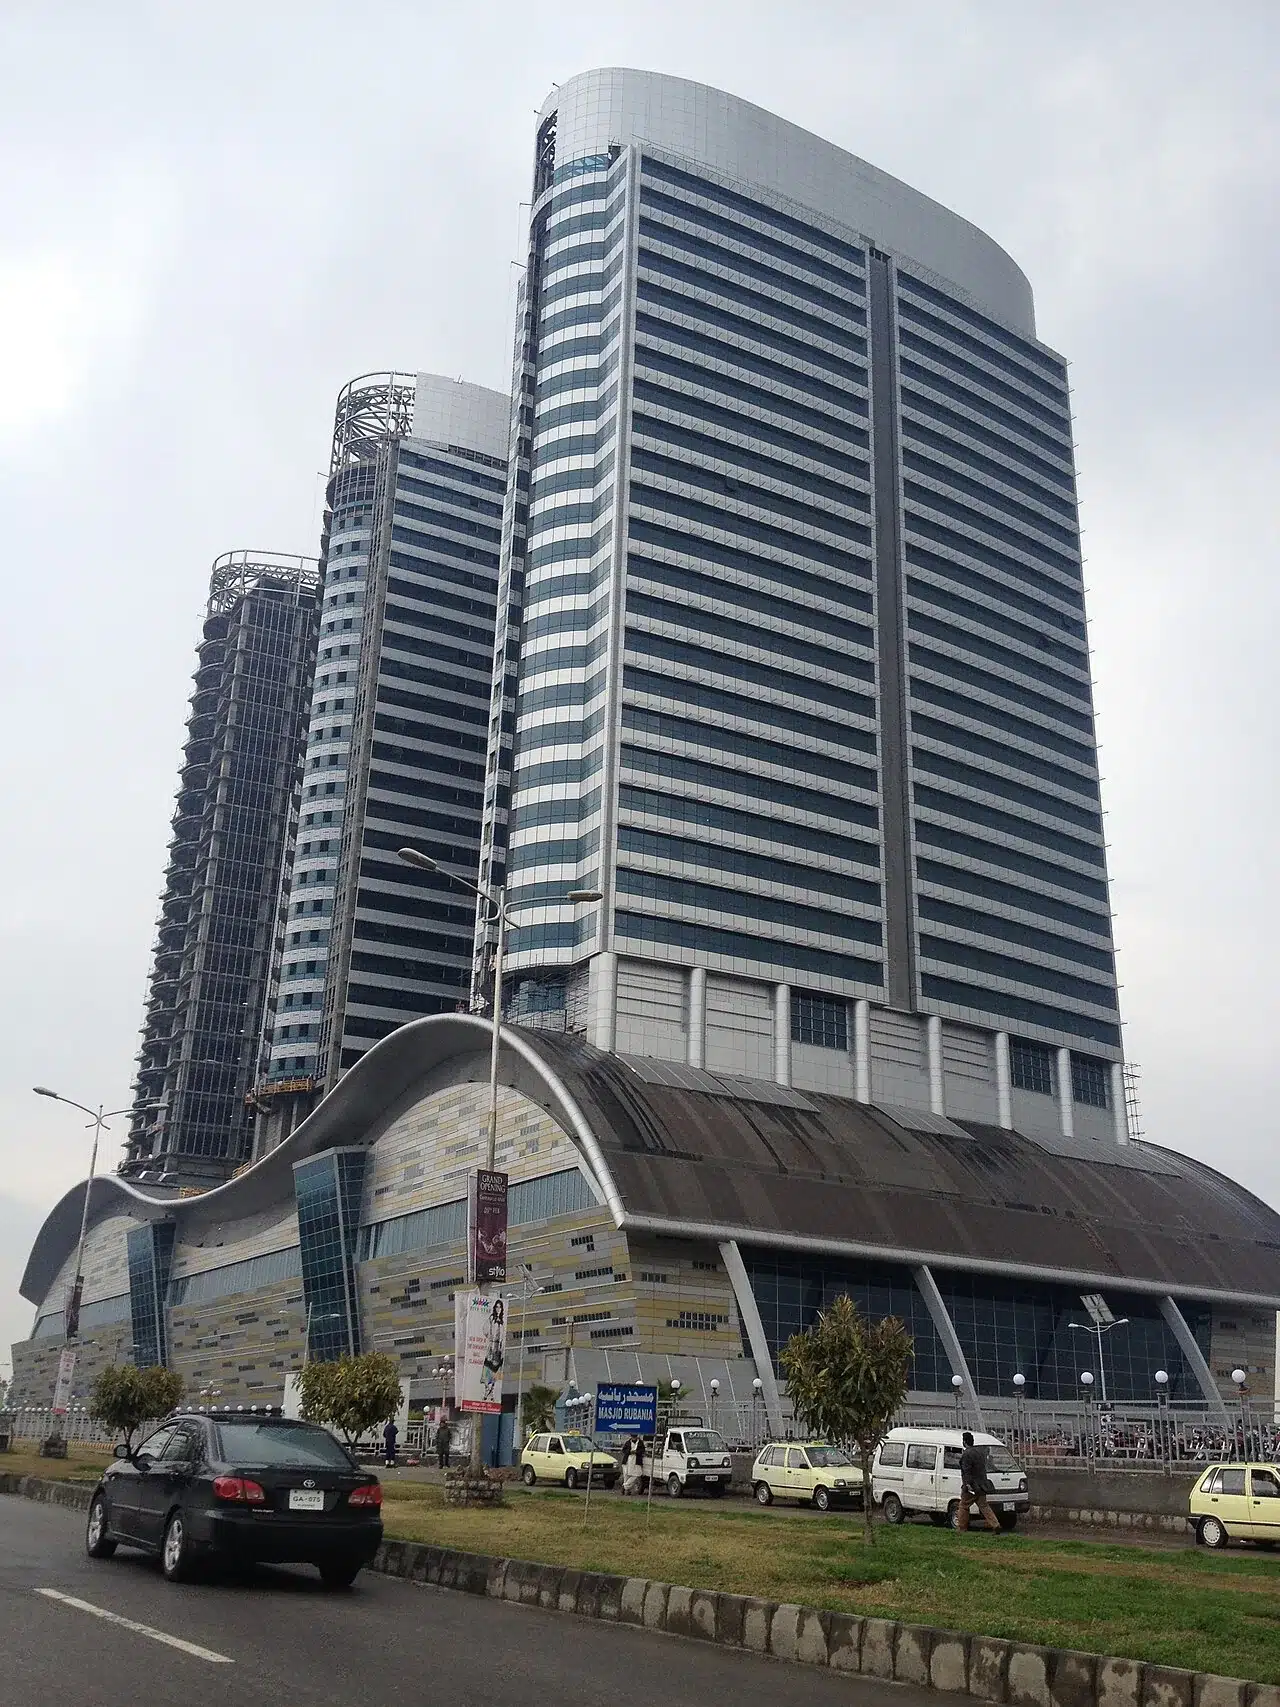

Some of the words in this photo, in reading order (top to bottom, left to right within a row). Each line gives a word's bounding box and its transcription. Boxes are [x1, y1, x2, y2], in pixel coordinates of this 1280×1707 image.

[482, 1174, 503, 1185] GRAND
[480, 1182, 506, 1193] OPENING
[627, 1391, 654, 1404] مسجد
[598, 1406, 623, 1419] MASJID
[624, 1407, 653, 1420] RUBANIA
